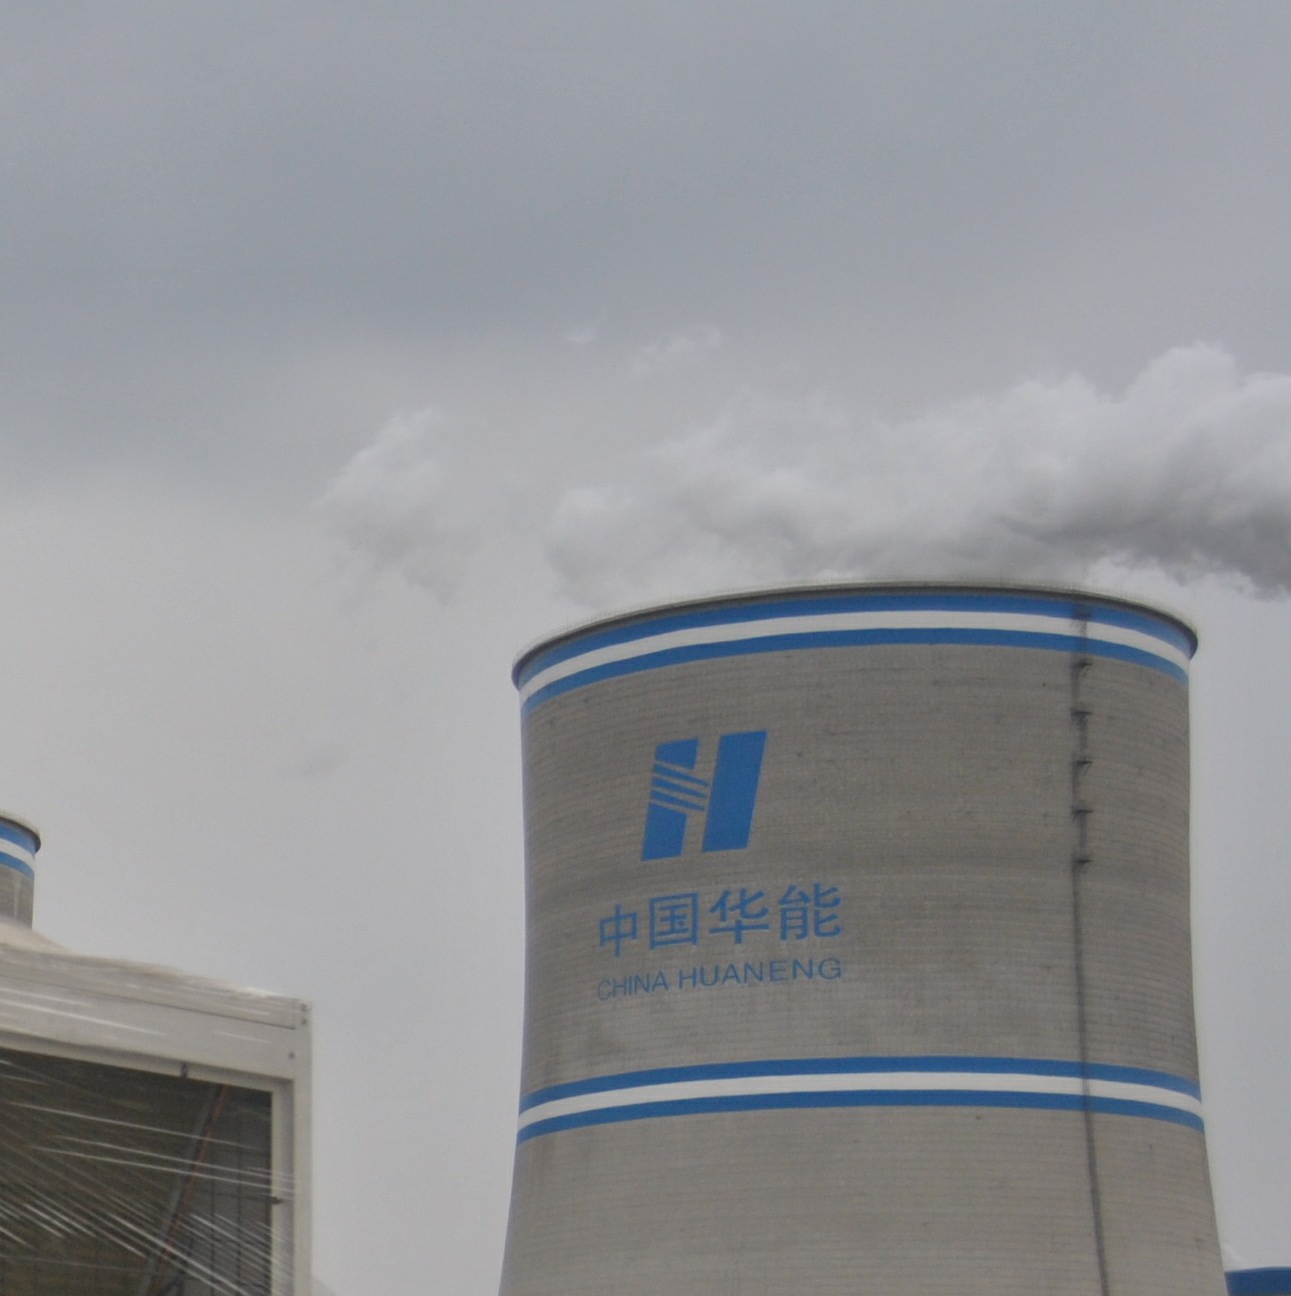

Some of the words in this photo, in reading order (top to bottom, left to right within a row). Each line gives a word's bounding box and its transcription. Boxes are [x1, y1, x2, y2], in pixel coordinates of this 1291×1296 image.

[598, 882, 843, 958] 中国华能
[596, 970, 669, 1001] CHINA
[678, 957, 842, 990] HUANENG
